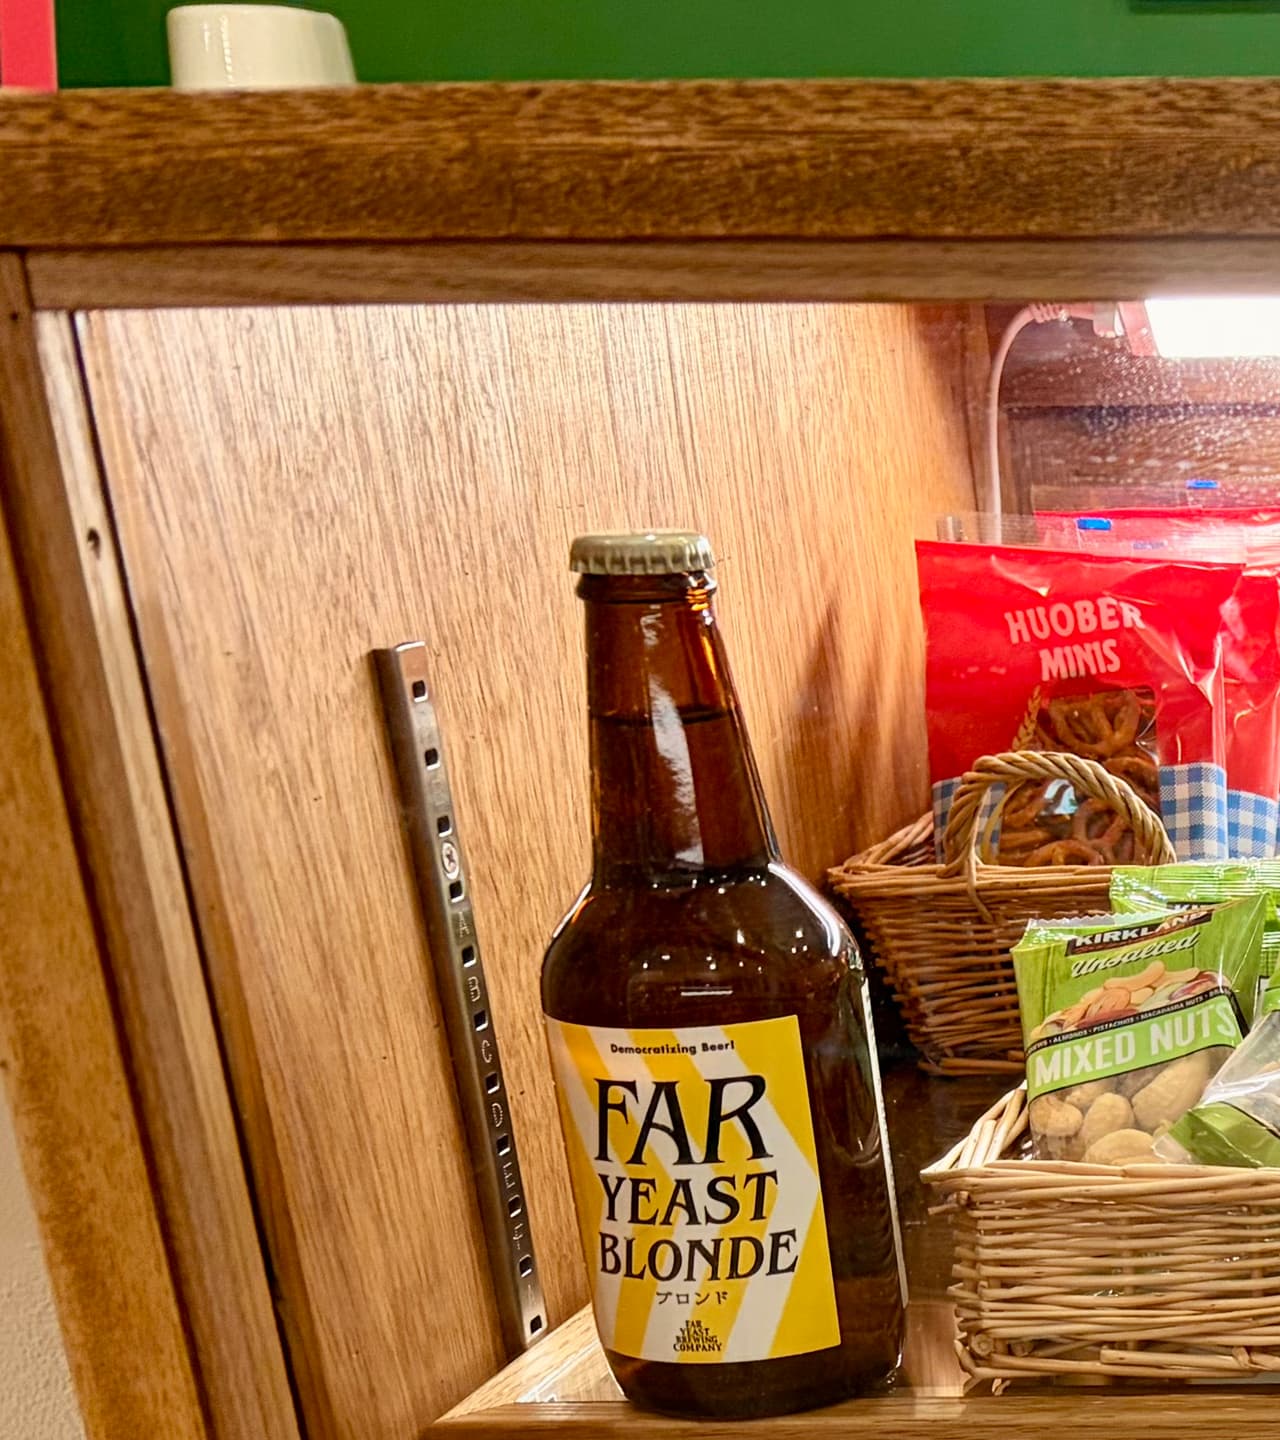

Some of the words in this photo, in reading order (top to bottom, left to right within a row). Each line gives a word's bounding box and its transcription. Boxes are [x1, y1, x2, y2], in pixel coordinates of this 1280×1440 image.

[1004, 598, 1146, 645] HUOBER
[1039, 638, 1121, 682] MINIS
[1071, 931, 1200, 978] Unsalted
[610, 1043, 698, 1056] Democratizing
[701, 1040, 735, 1053] Beer!
[1034, 1030, 1136, 1088] MIXED
[1150, 1002, 1237, 1056] NUTS
[593, 1074, 774, 1166] FAR
[597, 1170, 779, 1227] YEAST
[598, 1229, 800, 1283] BLONDE
[655, 1291, 729, 1306] ブロンド
[679, 1326, 711, 1336] YEAST
[684, 1319, 703, 1329] FAR
[672, 1341, 723, 1353] COMPANY
